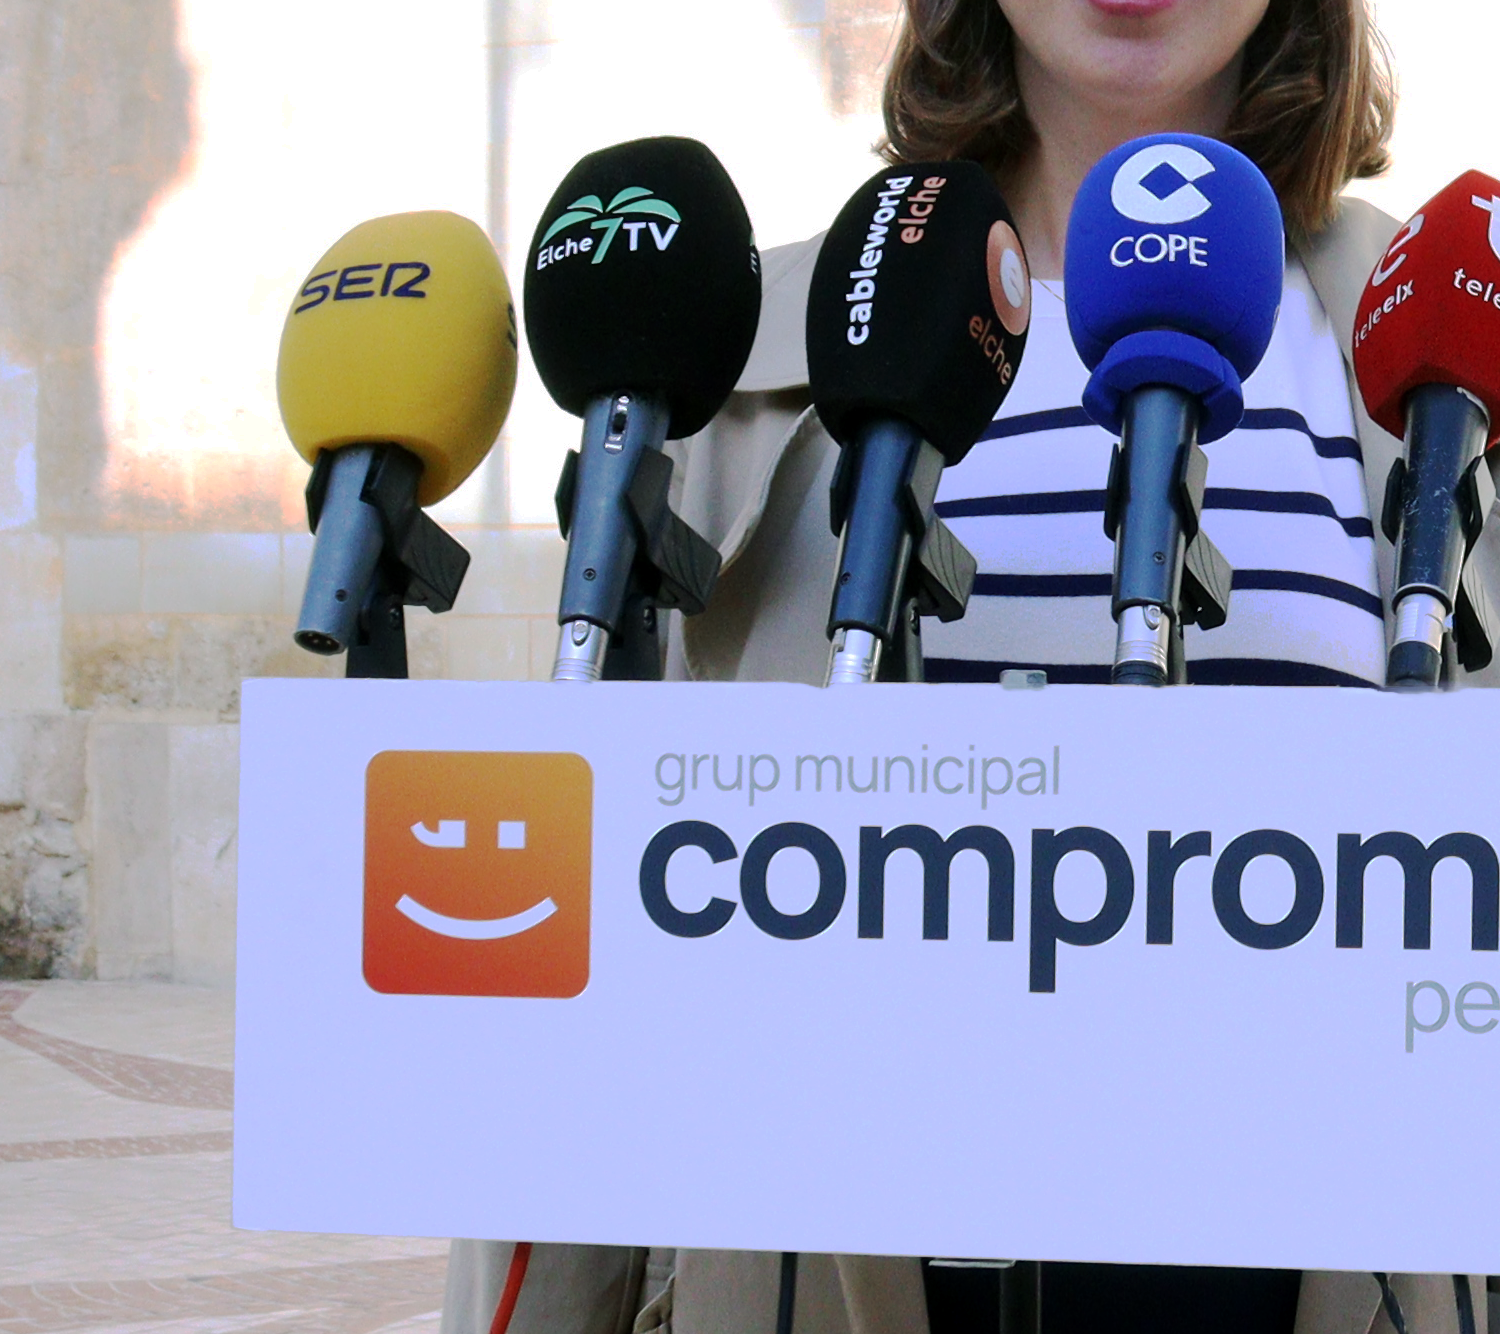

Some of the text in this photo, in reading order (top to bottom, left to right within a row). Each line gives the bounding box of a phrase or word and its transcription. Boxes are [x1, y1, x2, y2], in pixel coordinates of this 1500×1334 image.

[897, 175, 947, 245] elche
[536, 237, 594, 271] Elche
[845, 175, 914, 346] cableworld
[1110, 233, 1209, 268] COPE
[295, 261, 431, 315] SER
[1355, 279, 1416, 349] teleelx
[969, 314, 1012, 385] elche
[654, 744, 1060, 811] grup municipal
